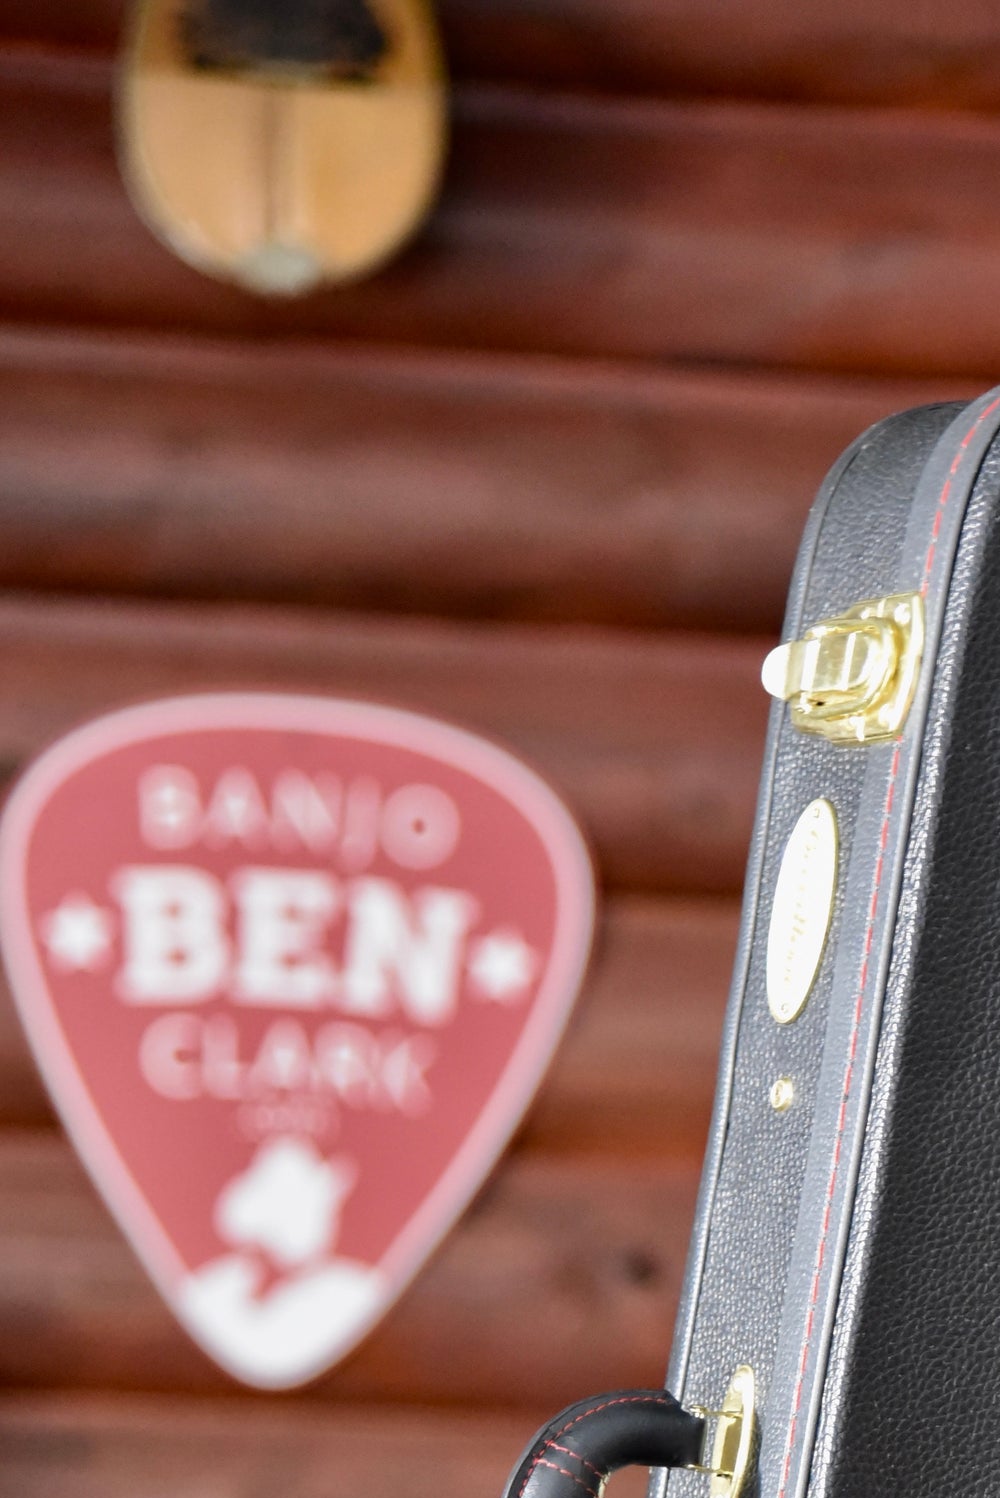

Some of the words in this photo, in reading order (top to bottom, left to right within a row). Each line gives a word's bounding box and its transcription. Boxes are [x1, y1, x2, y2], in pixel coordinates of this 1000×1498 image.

[139, 765, 461, 871] BANJO
[113, 864, 481, 1025] BEN
[140, 1012, 436, 1117] CLARK
